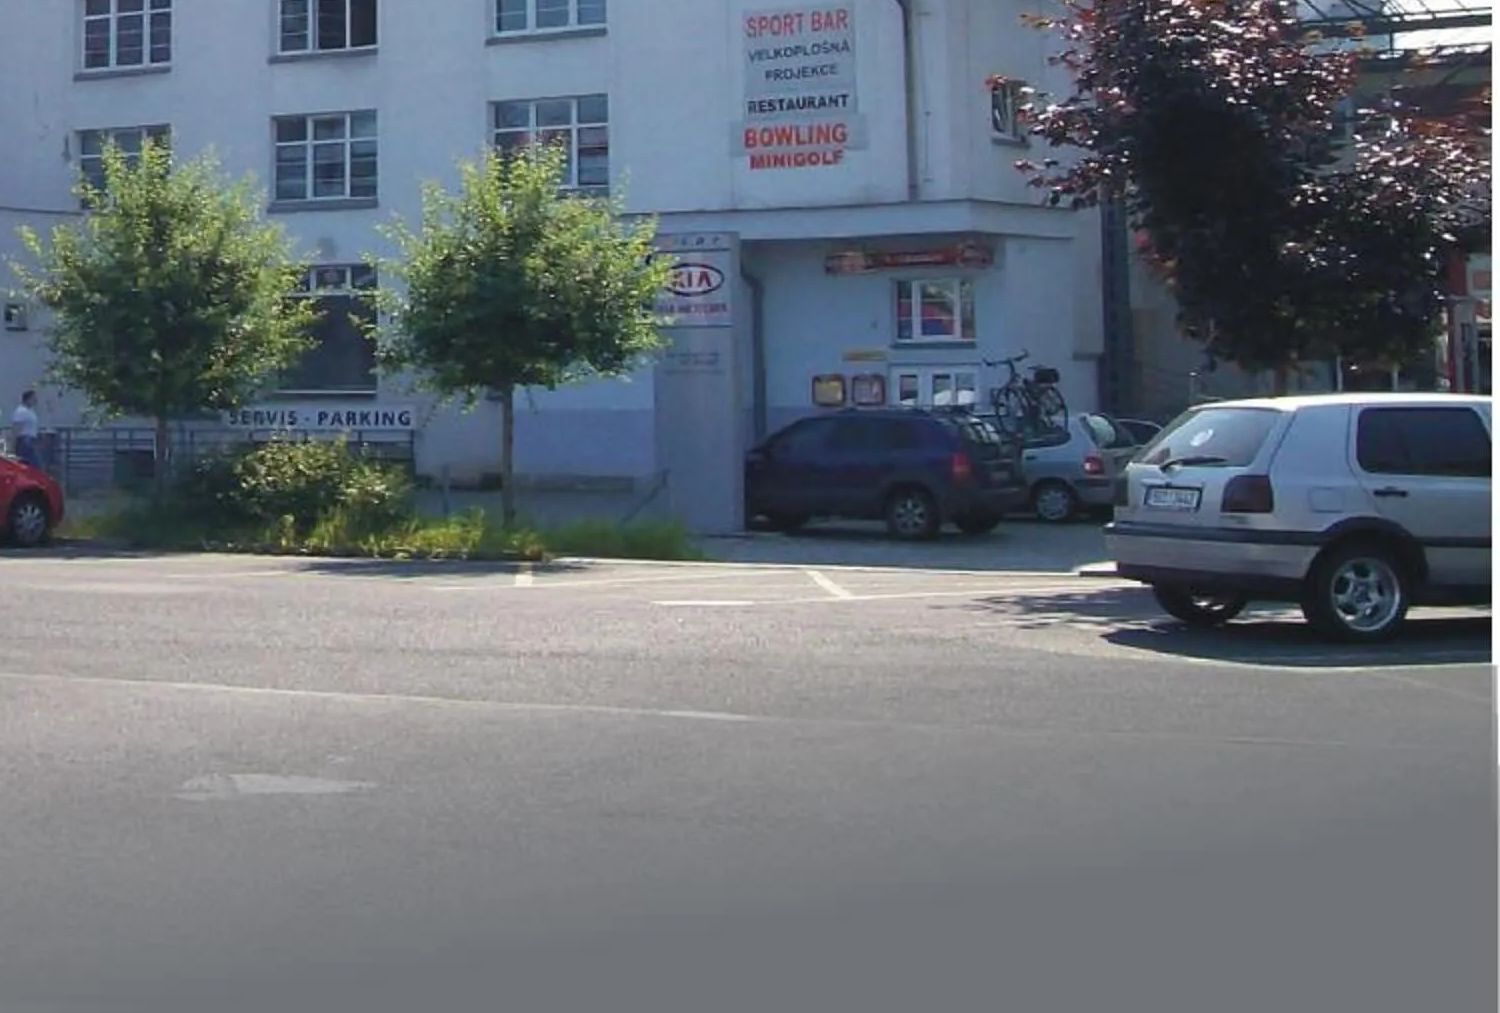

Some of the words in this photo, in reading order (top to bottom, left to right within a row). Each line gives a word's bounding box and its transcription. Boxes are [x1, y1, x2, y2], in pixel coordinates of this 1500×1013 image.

[745, 13, 805, 39] SPORT
[811, 8, 849, 33] BAR
[764, 62, 839, 82] PROJEKCE
[747, 94, 850, 115] RESTAURANT
[744, 123, 849, 149] BOWLING
[749, 149, 845, 170] MINIGOLF
[228, 410, 299, 427] SERVIS
[317, 409, 412, 428] PARKING
